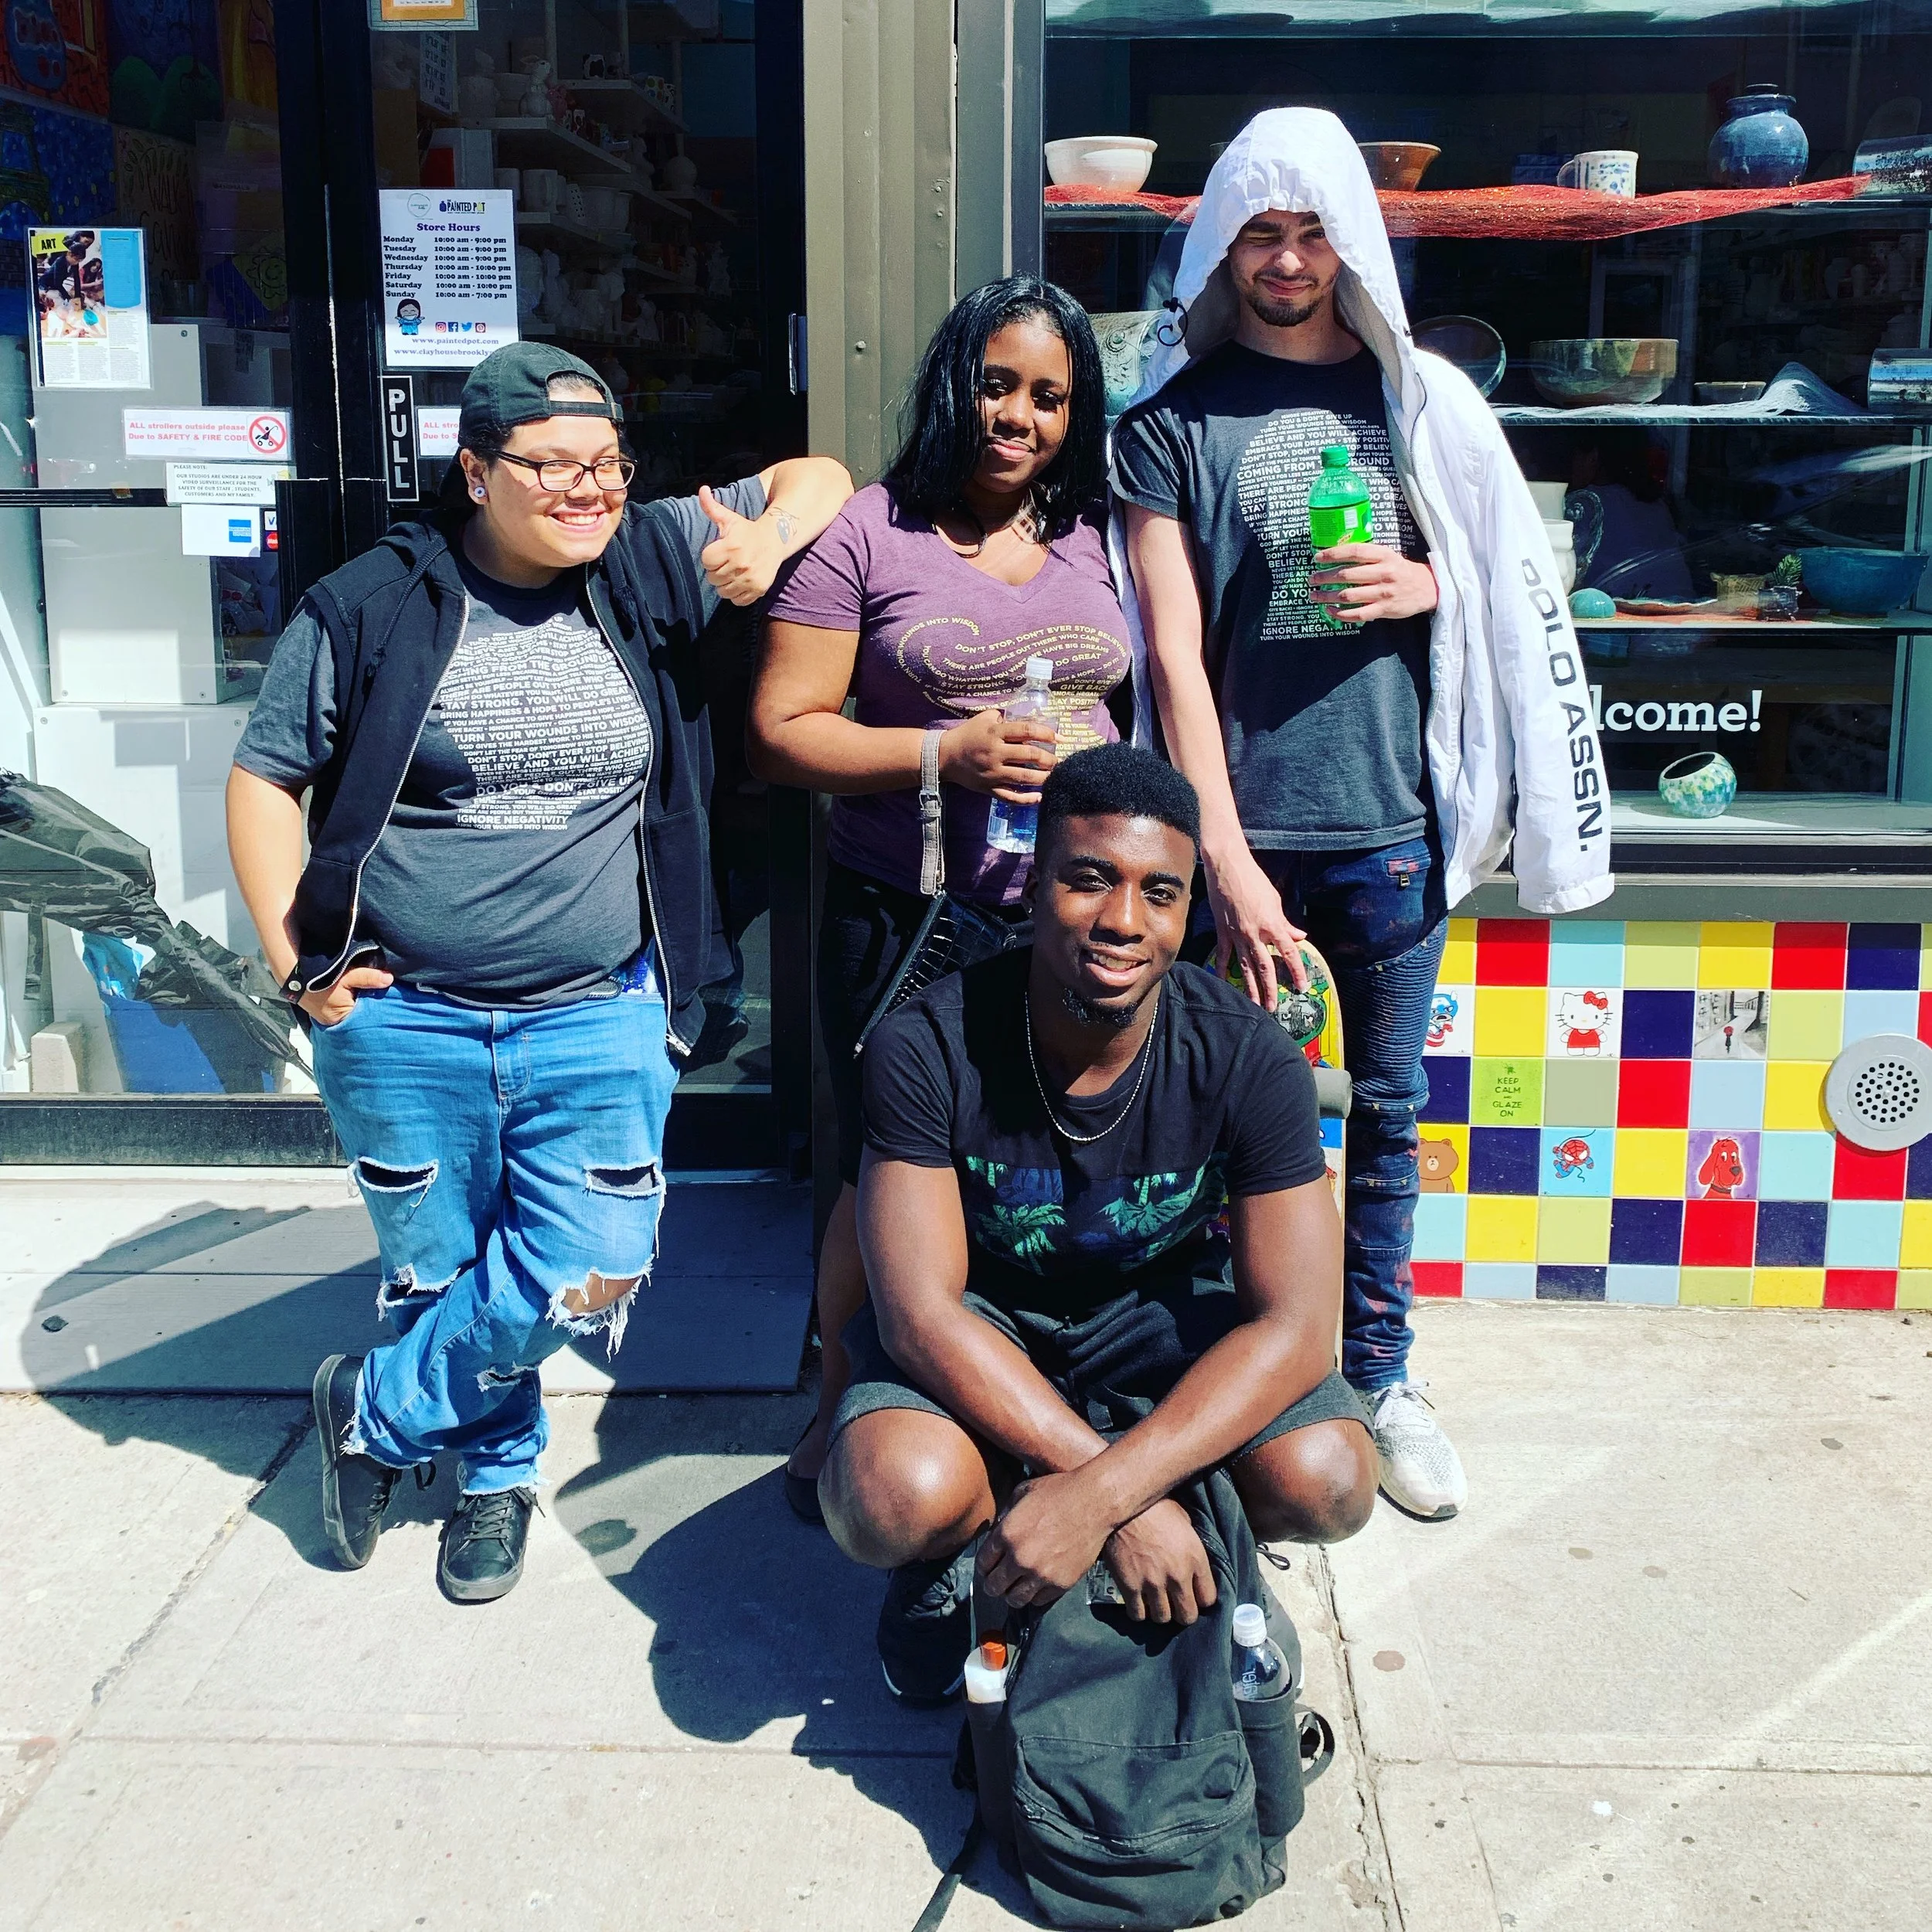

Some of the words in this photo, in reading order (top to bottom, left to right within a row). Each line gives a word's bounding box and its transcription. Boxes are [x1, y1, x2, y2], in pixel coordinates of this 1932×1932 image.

[447, 202, 471, 212] PAINTED
[417, 223, 446, 232] Store
[448, 223, 481, 232] Hours
[41, 238, 56, 250] ART
[389, 389, 410, 488] PULL
[1249, 435, 1285, 447] BELIEVE
[1327, 429, 1349, 437] WILL
[927, 617, 949, 626] INTO
[951, 617, 980, 635] WISDOM
[1263, 626, 1298, 635] IGNORE
[898, 622, 925, 649] WOUNDS
[955, 643, 986, 653] DON'T
[988, 639, 1015, 651] STOP,
[1015, 629, 1044, 642] DON'T
[1046, 625, 1072, 634] EVER
[1074, 625, 1096, 634] STOP
[1097, 630, 1126, 657] BELIEVING
[897, 649, 906, 668] YOUR
[943, 658, 967, 670] THERE
[986, 651, 1015, 666] PEOPLE
[1016, 645, 1031, 654] OUT
[1032, 636, 1058, 648] THERE
[1055, 658, 1070, 667] DO
[1072, 652, 1101, 662] GREAT
[903, 666, 922, 683] TURN
[1522, 558, 1577, 687] POLO
[1559, 701, 1603, 852] ASSN.
[1589, 685, 1762, 732] lcome!
[452, 733, 485, 743] TURN
[488, 730, 522, 741] YOUR
[524, 725, 578, 739] WOUNDS
[580, 722, 607, 732] INTO
[468, 756, 498, 764] DON'T
[500, 753, 526, 762] STOP,
[528, 750, 558, 760] DON'T
[560, 747, 583, 757] EVER
[586, 745, 608, 754] STOP
[610, 736, 648, 751] BELIEVING
[471, 762, 520, 772] BELIEVE
[523, 759, 549, 768] AND
[553, 757, 577, 767] YOU
[580, 753, 608, 764] WILL
[611, 743, 650, 757] ACHIEVE
[457, 815, 502, 824] IGNORE
[504, 815, 570, 824] NEGATIVITY
